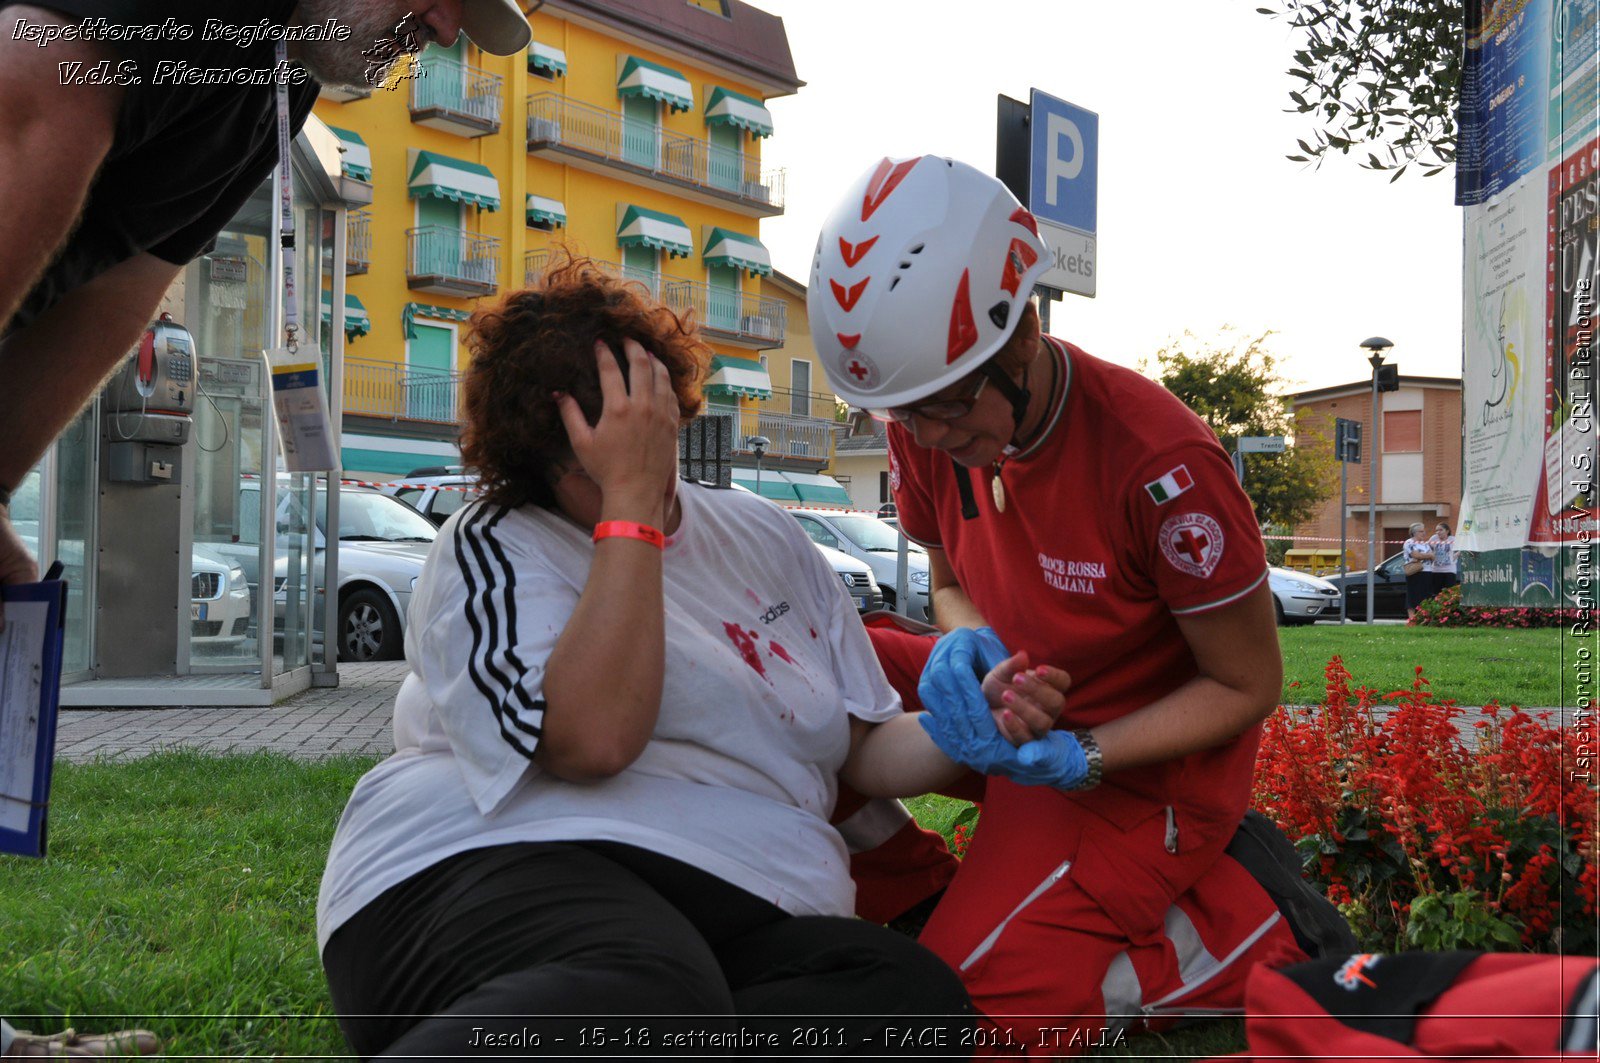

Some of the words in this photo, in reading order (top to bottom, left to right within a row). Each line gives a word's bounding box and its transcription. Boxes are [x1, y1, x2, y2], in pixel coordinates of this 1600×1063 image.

[1046, 112, 1085, 206] P
[1052, 246, 1093, 277] kets
[1038, 552, 1066, 575] CROCE
[1067, 561, 1107, 578] ROSSA
[1044, 569, 1095, 594] ITALIANA
